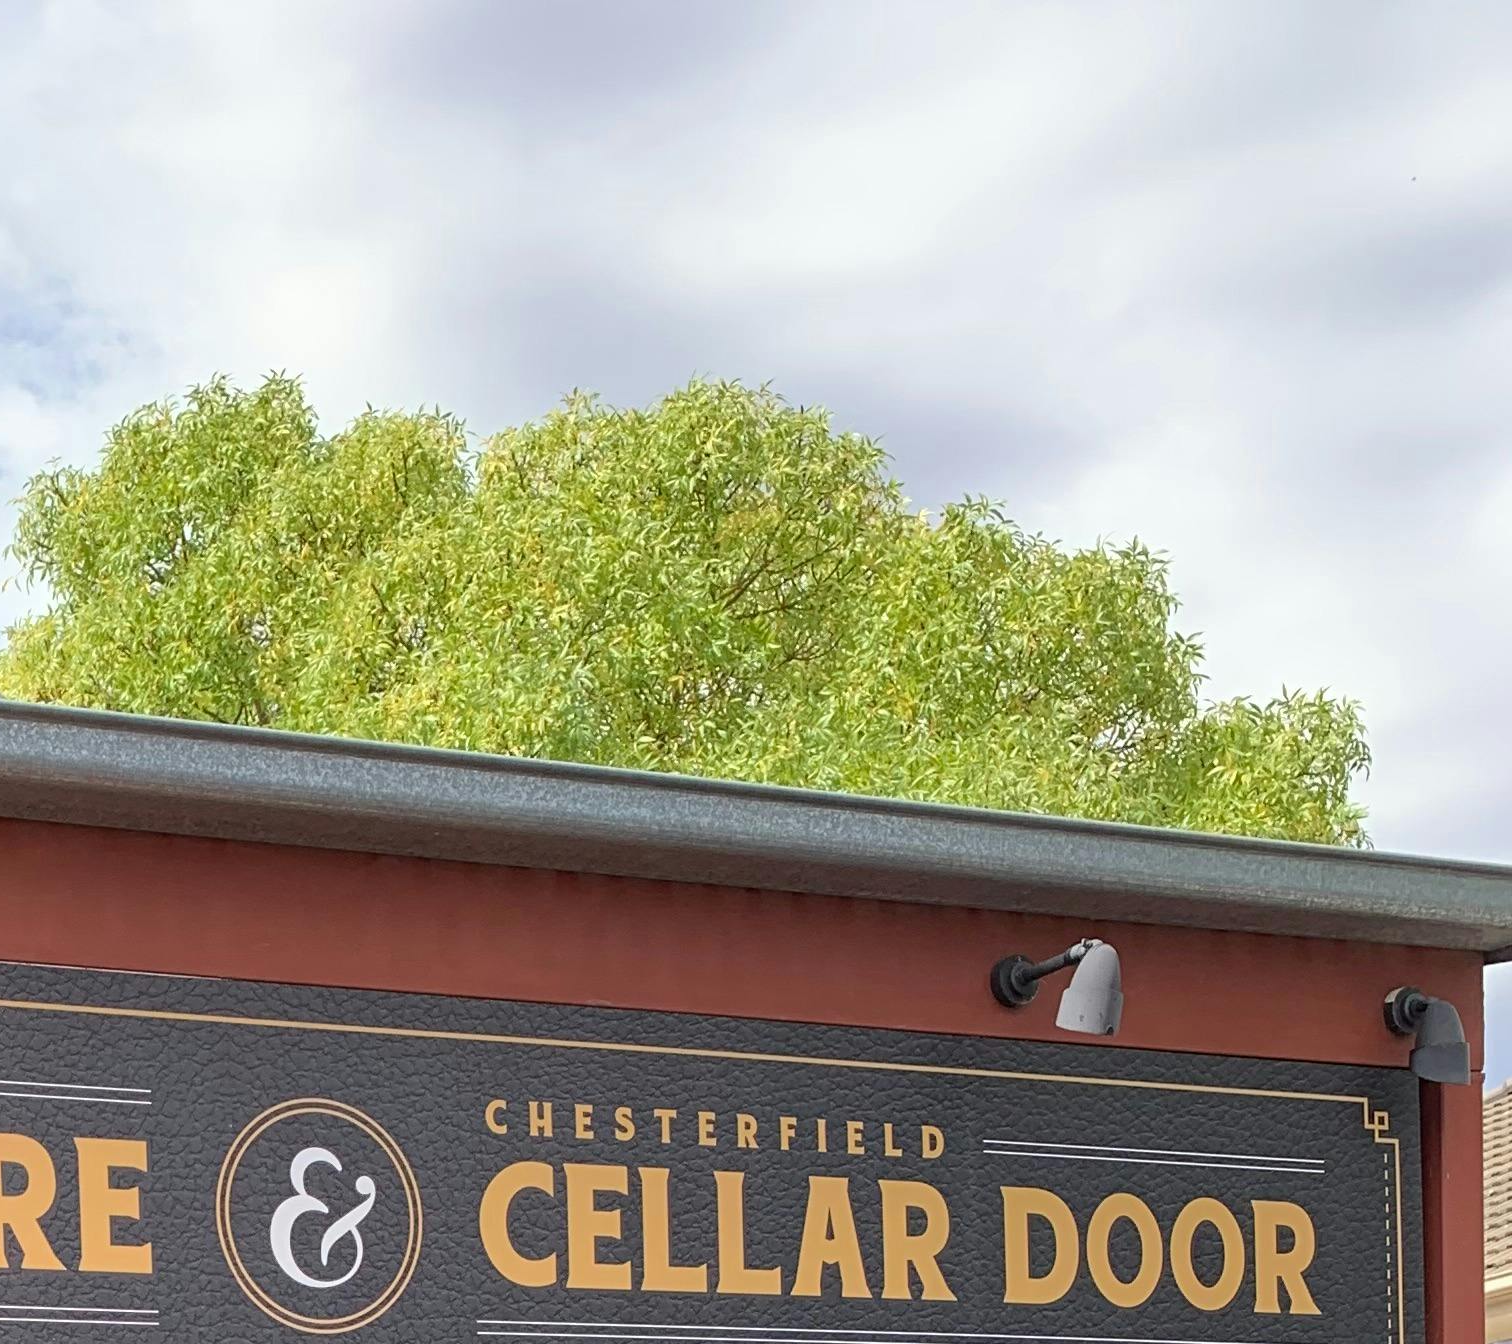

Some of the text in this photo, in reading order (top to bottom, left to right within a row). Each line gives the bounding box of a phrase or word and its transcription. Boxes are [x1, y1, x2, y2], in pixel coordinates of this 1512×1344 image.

[486, 1099, 947, 1158] CHESTERFIELD
[269, 1146, 377, 1289] &
[478, 1160, 1322, 1316] CELLAR DOOR
